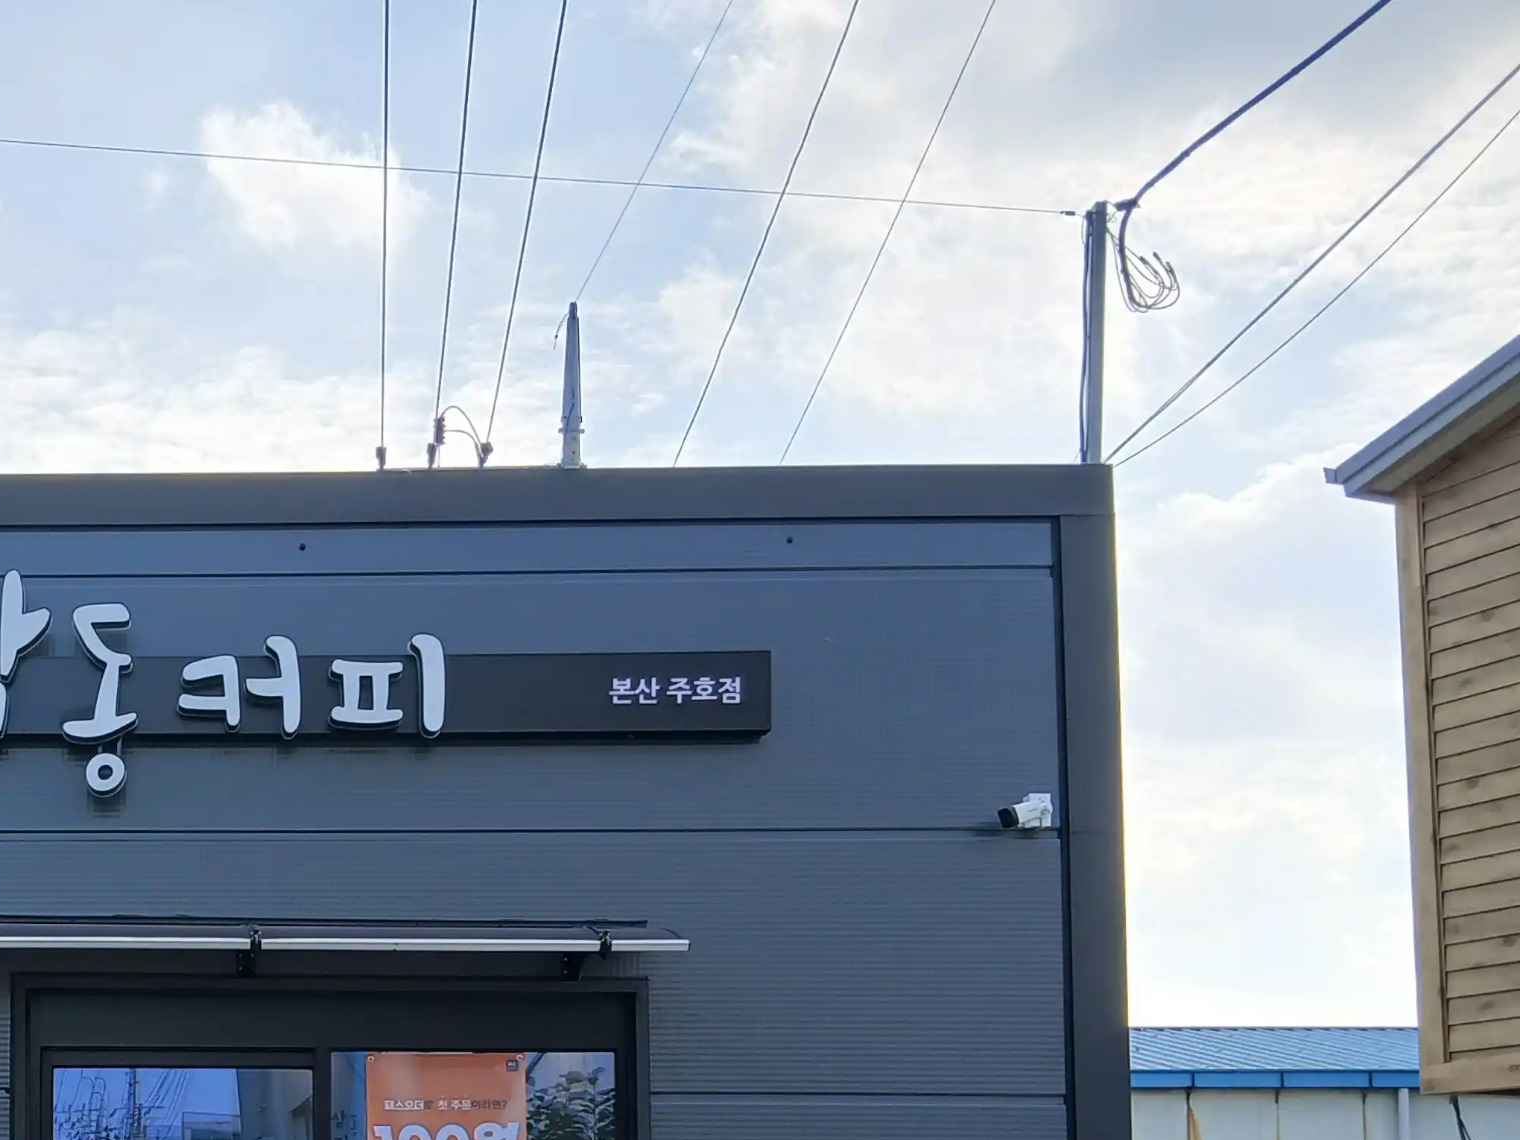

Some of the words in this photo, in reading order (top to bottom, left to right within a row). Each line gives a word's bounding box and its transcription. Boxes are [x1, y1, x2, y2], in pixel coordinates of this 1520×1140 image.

[176, 632, 447, 739] 커피
[607, 675, 661, 707] 본산
[665, 675, 743, 707] 주호점
